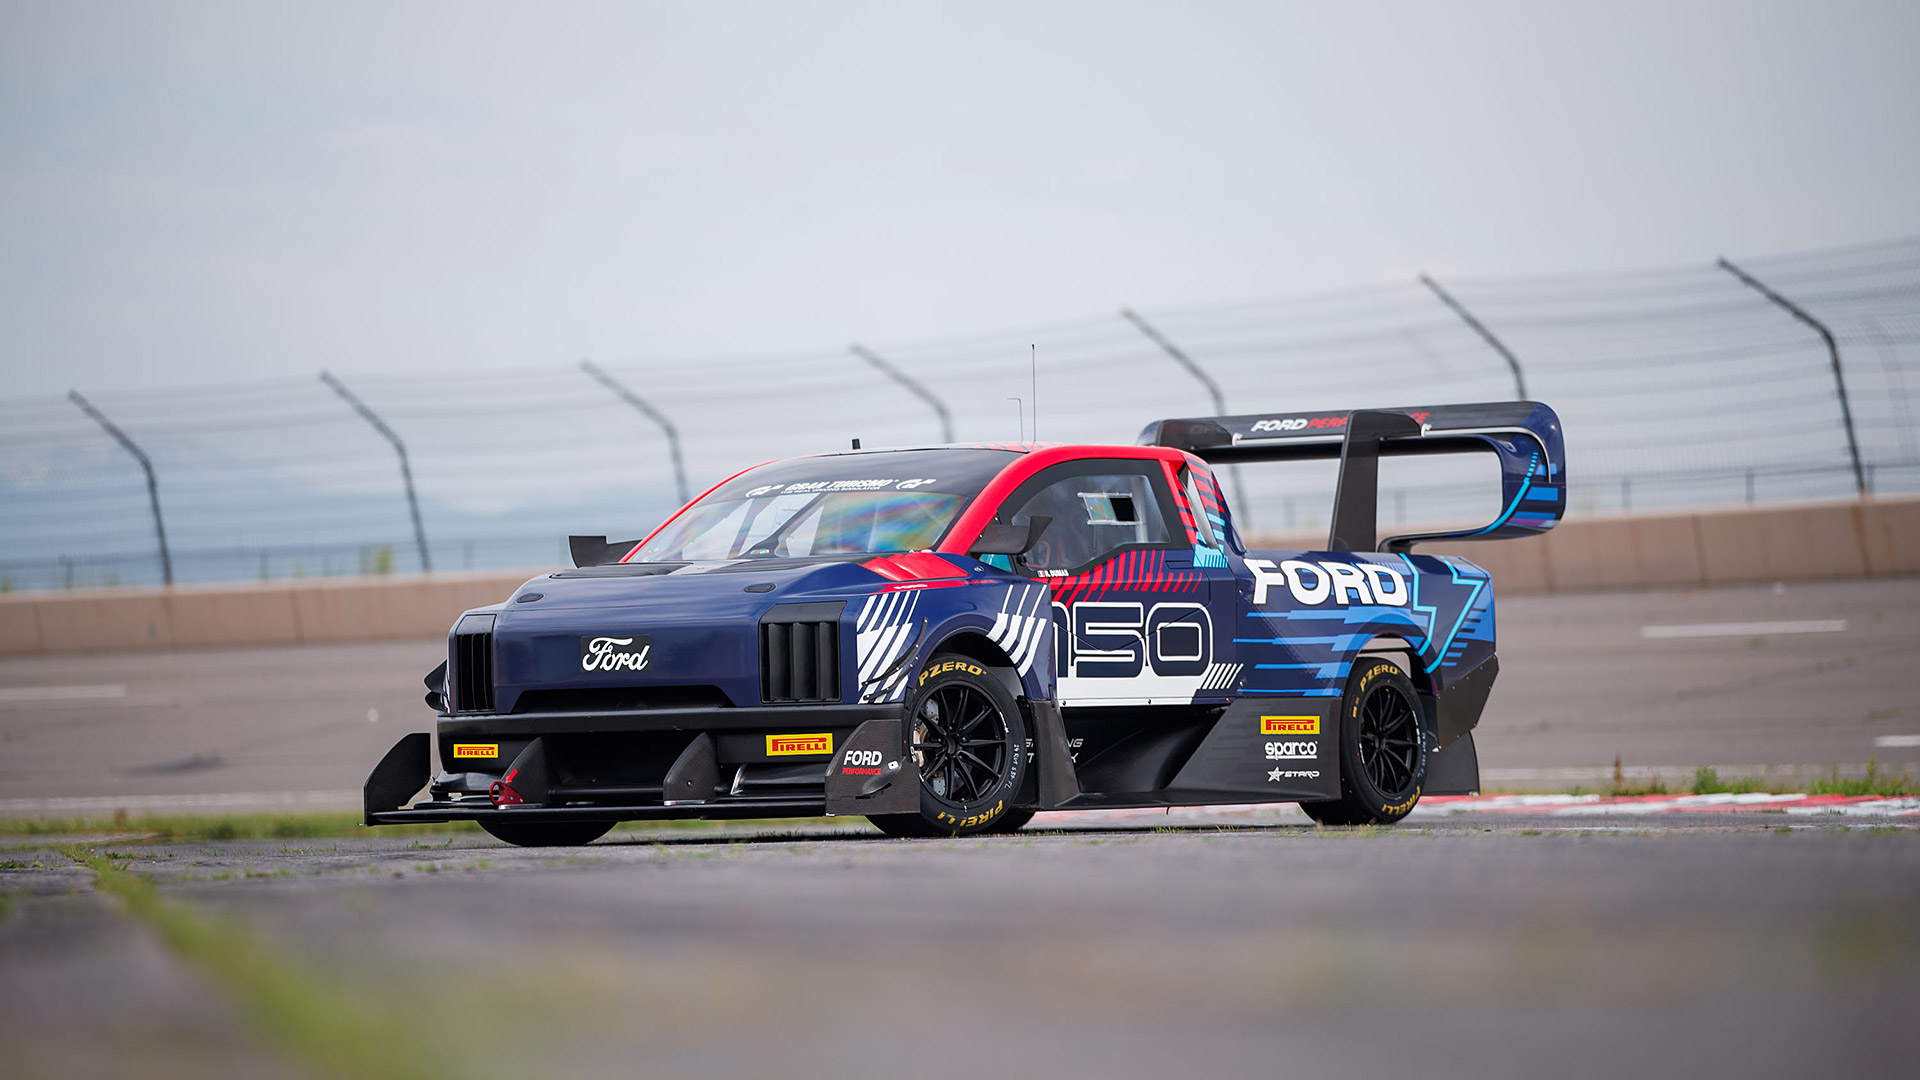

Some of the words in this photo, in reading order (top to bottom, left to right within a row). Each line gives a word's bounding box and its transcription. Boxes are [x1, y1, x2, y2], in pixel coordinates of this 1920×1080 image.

[1251, 418, 1307, 432] FORD
[785, 481, 829, 492] GRAN
[826, 479, 893, 490] TURISMO
[1243, 558, 1408, 607] FORD
[582, 637, 651, 671] Ford
[1360, 664, 1399, 692] PZERO
[1265, 719, 1316, 731] PIRELLI
[457, 746, 495, 756] PIRELLI
[771, 737, 828, 752] PIRELLI
[1264, 741, 1318, 760] sparco
[843, 750, 883, 766] FORD
[842, 767, 882, 776] PERFORMANCE
[1284, 770, 1320, 779] STARD
[1381, 785, 1421, 815] PIRELLI
